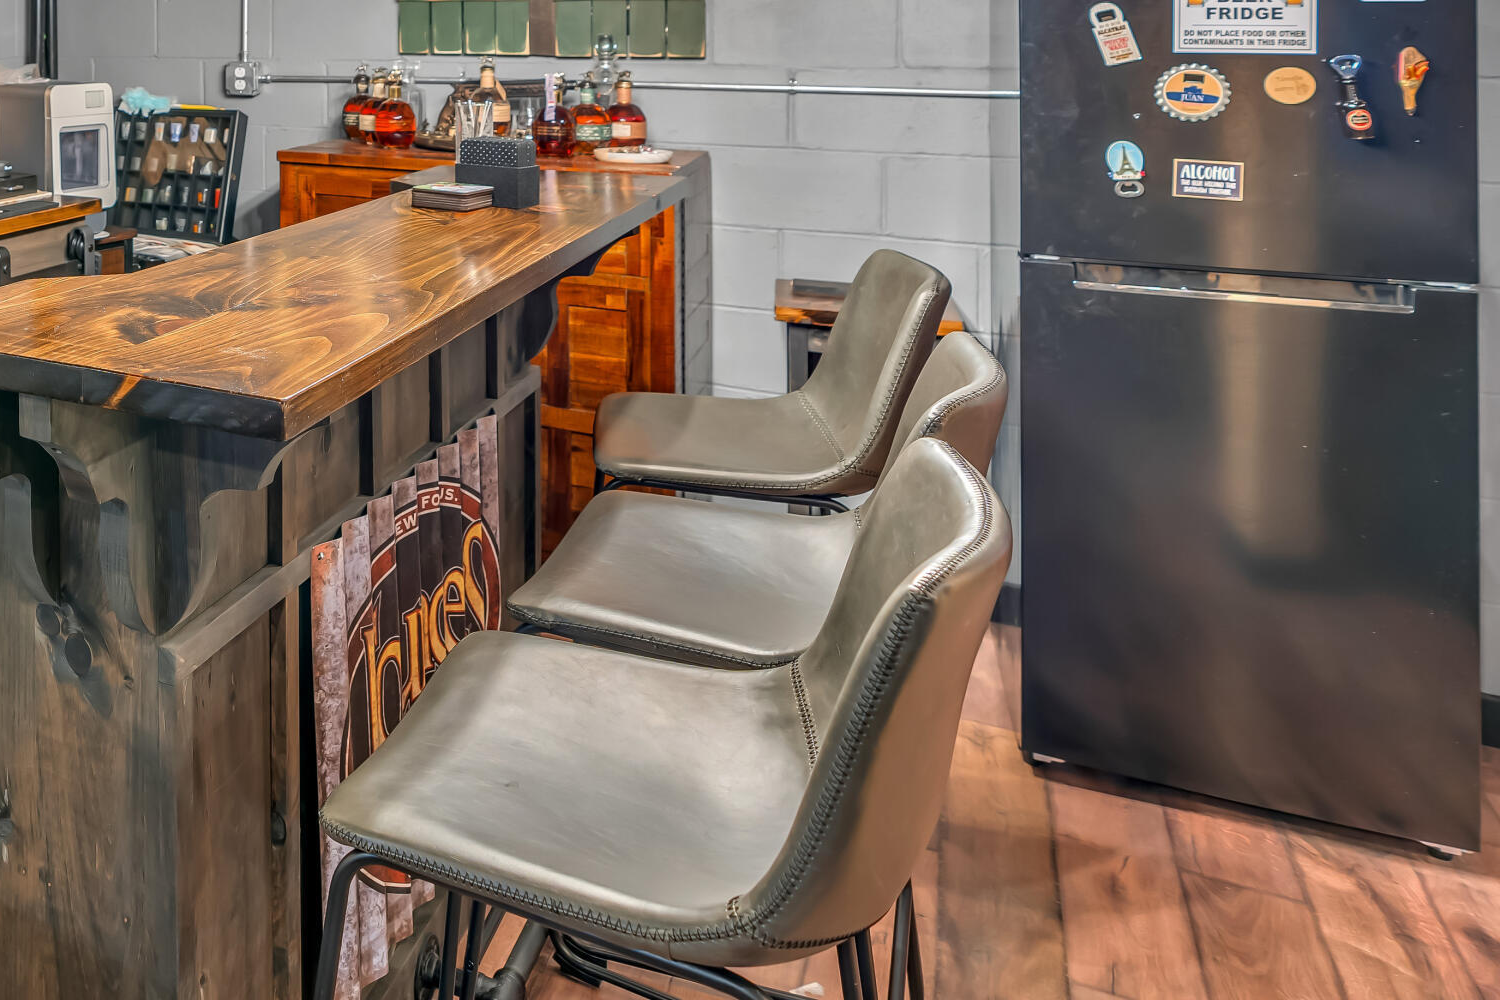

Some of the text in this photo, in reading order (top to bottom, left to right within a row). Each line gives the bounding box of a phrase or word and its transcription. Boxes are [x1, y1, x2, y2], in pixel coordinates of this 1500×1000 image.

[1206, 7, 1284, 20] FRIDGE
[1183, 38, 1244, 46] CONTAMINANTS
[1278, 39, 1307, 47] FRIDGE
[1181, 164, 1236, 182] ALCOHOL
